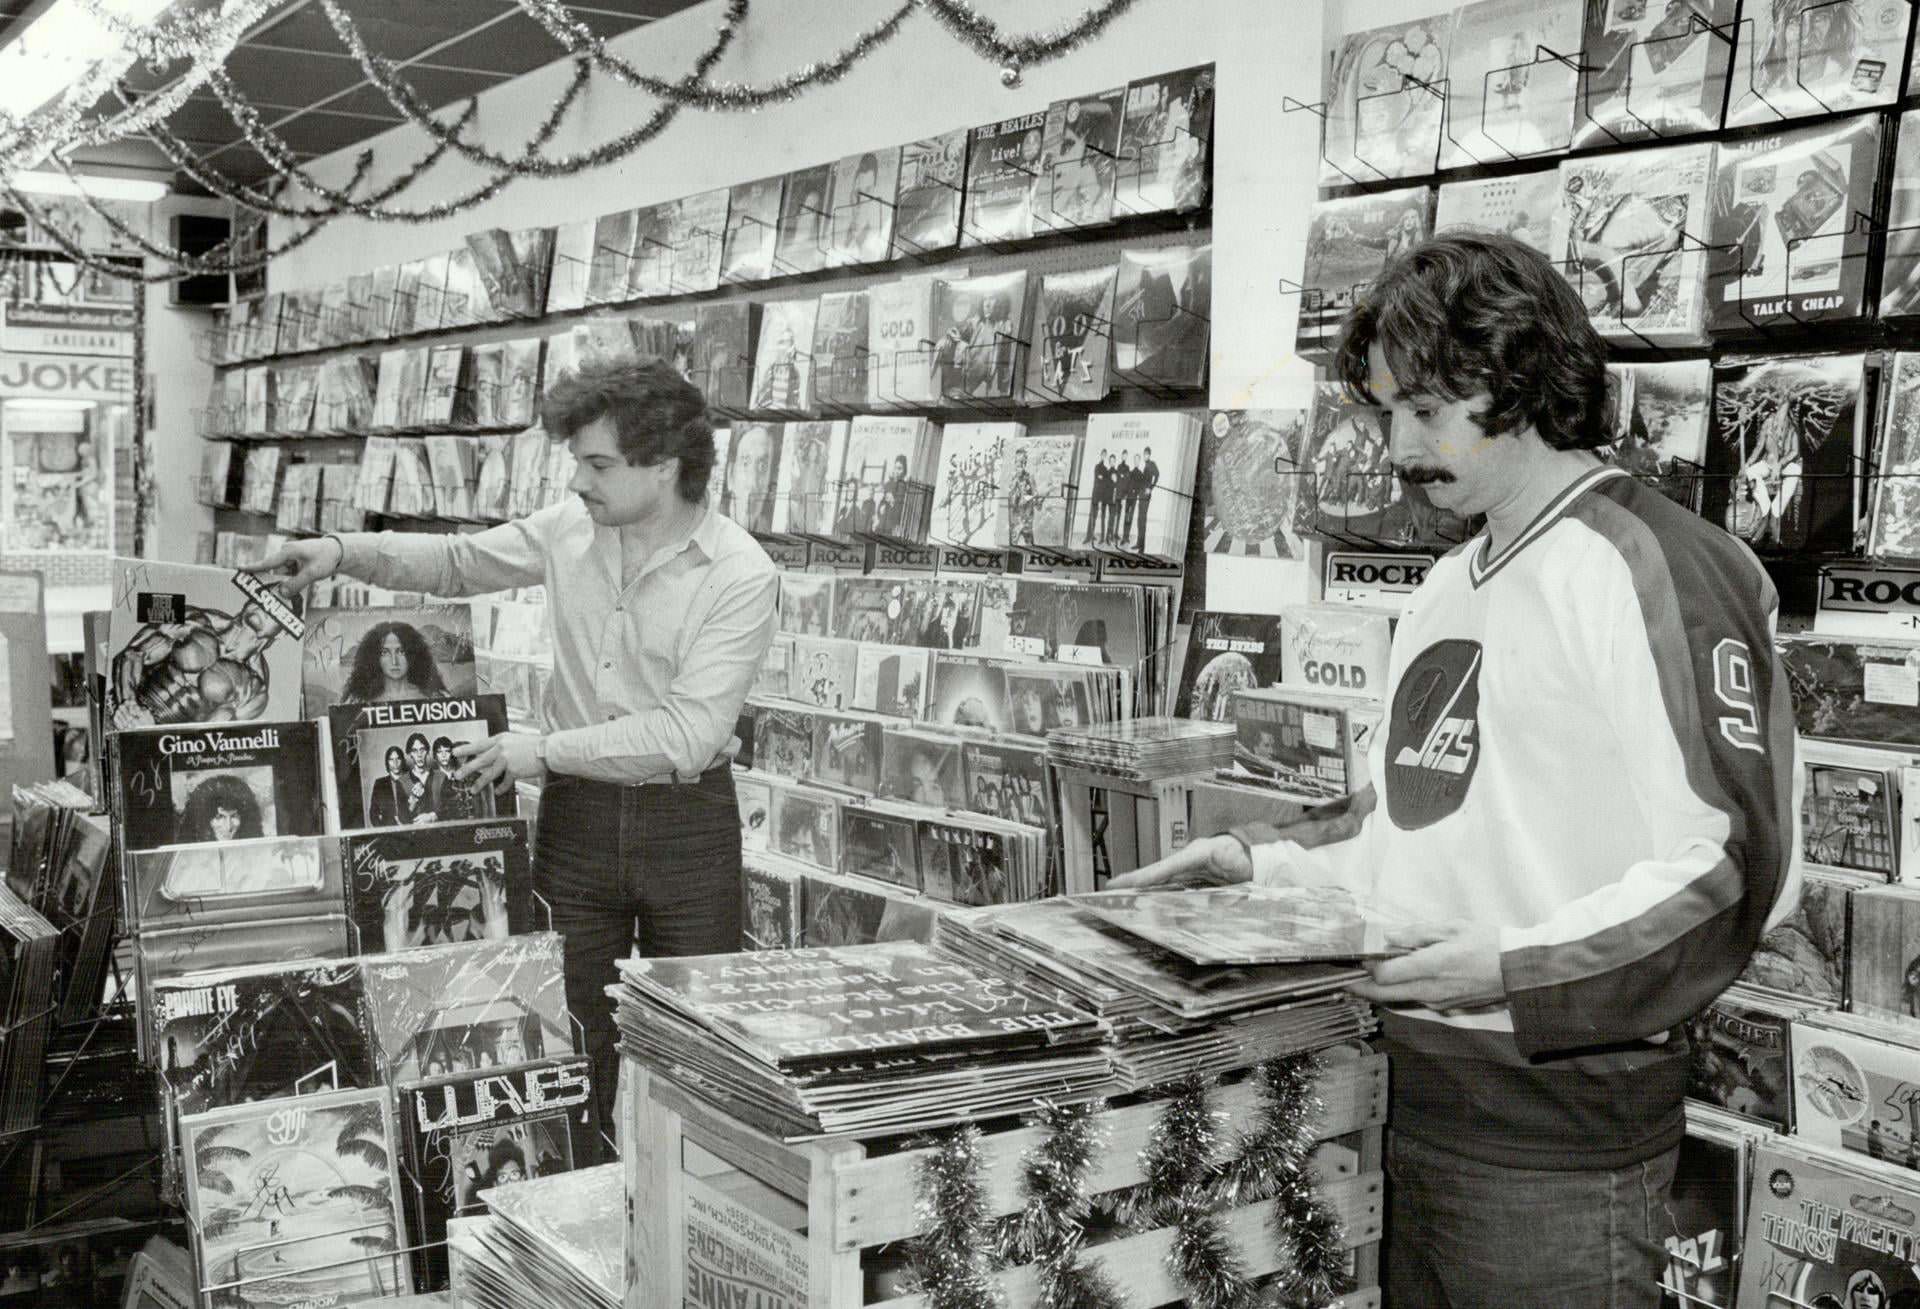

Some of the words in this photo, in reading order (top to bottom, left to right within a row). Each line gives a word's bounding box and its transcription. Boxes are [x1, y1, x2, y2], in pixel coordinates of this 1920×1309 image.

[976, 125, 997, 140] THE
[1000, 113, 1044, 135] BEATLES
[991, 143, 1020, 162] Live!
[1753, 300, 1792, 315] TALK'S
[1802, 296, 1844, 312] CHEAP
[881, 319, 914, 338] GOLD
[0, 362, 132, 391] JOKE
[814, 551, 860, 563] ROCK
[880, 551, 932, 565] ROCK
[944, 551, 1001, 569] ROCK
[1334, 563, 1427, 584] ROCK
[1304, 660, 1367, 689] GOLD
[362, 700, 477, 726] TELEVISION
[1394, 649, 1476, 774] JETS
[159, 734, 206, 755] Gino
[205, 728, 280, 752] Vannelli
[998, 1010, 1080, 1034] THE
[788, 1022, 971, 1056] BEATLES
[1800, 1199, 1841, 1234] THE
[1761, 1211, 1838, 1265] THINGS!
